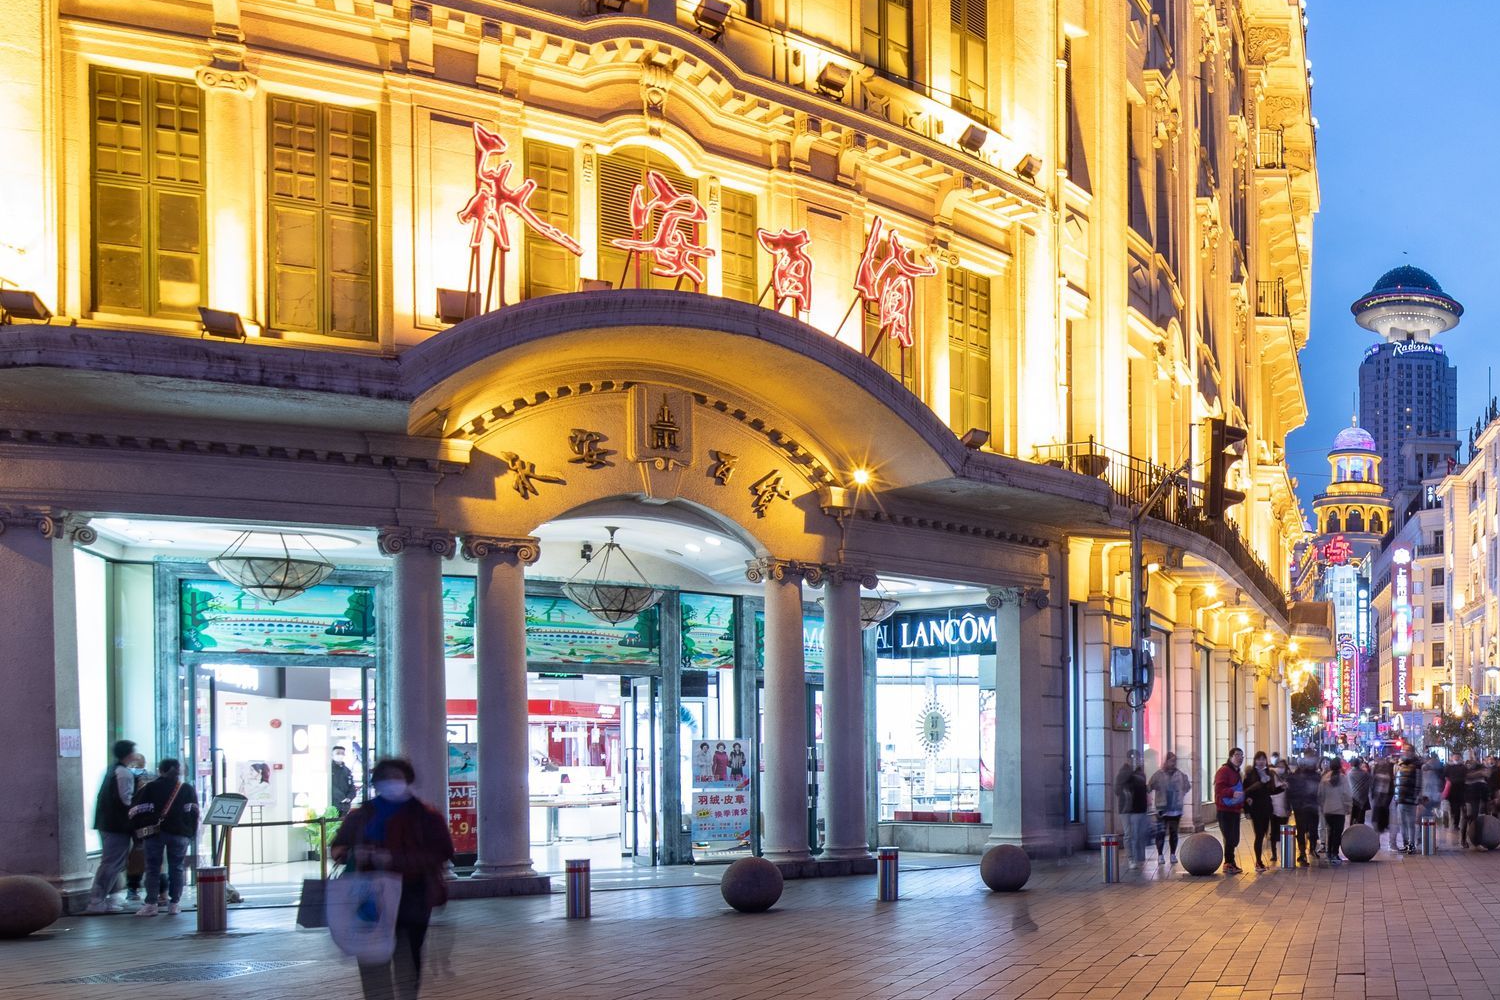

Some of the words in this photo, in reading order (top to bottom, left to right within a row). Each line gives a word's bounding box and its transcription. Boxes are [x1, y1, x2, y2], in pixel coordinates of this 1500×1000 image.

[1392, 339, 1434, 357] Radisson
[901, 612, 997, 648] LANCÔM
[214, 804, 239, 816] 入口
